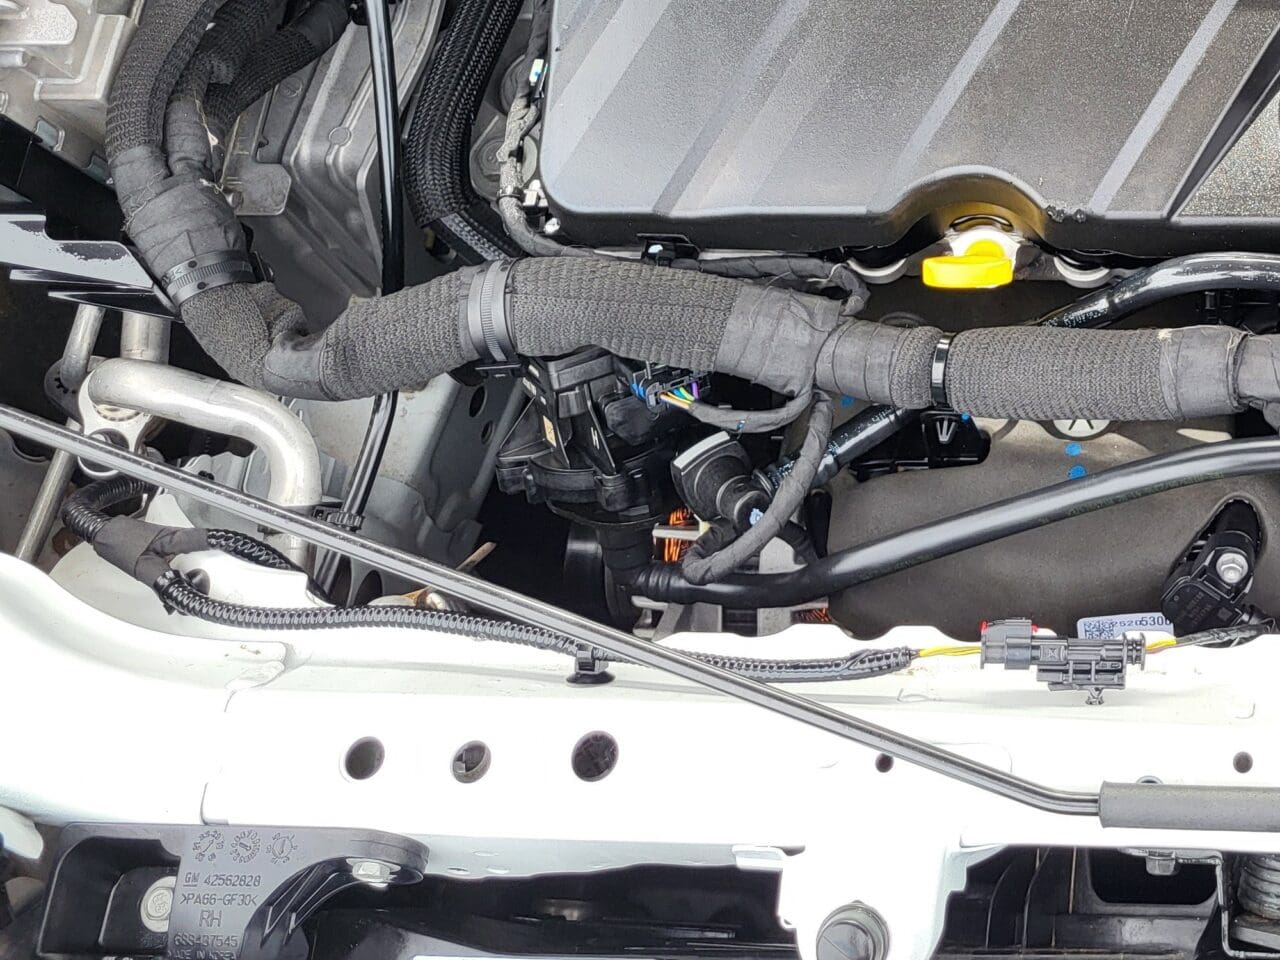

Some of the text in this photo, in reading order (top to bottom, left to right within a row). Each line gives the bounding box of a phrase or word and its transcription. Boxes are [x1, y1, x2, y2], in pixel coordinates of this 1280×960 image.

[184, 872, 262, 887] GM 42562828
[200, 910, 222, 928] RH
